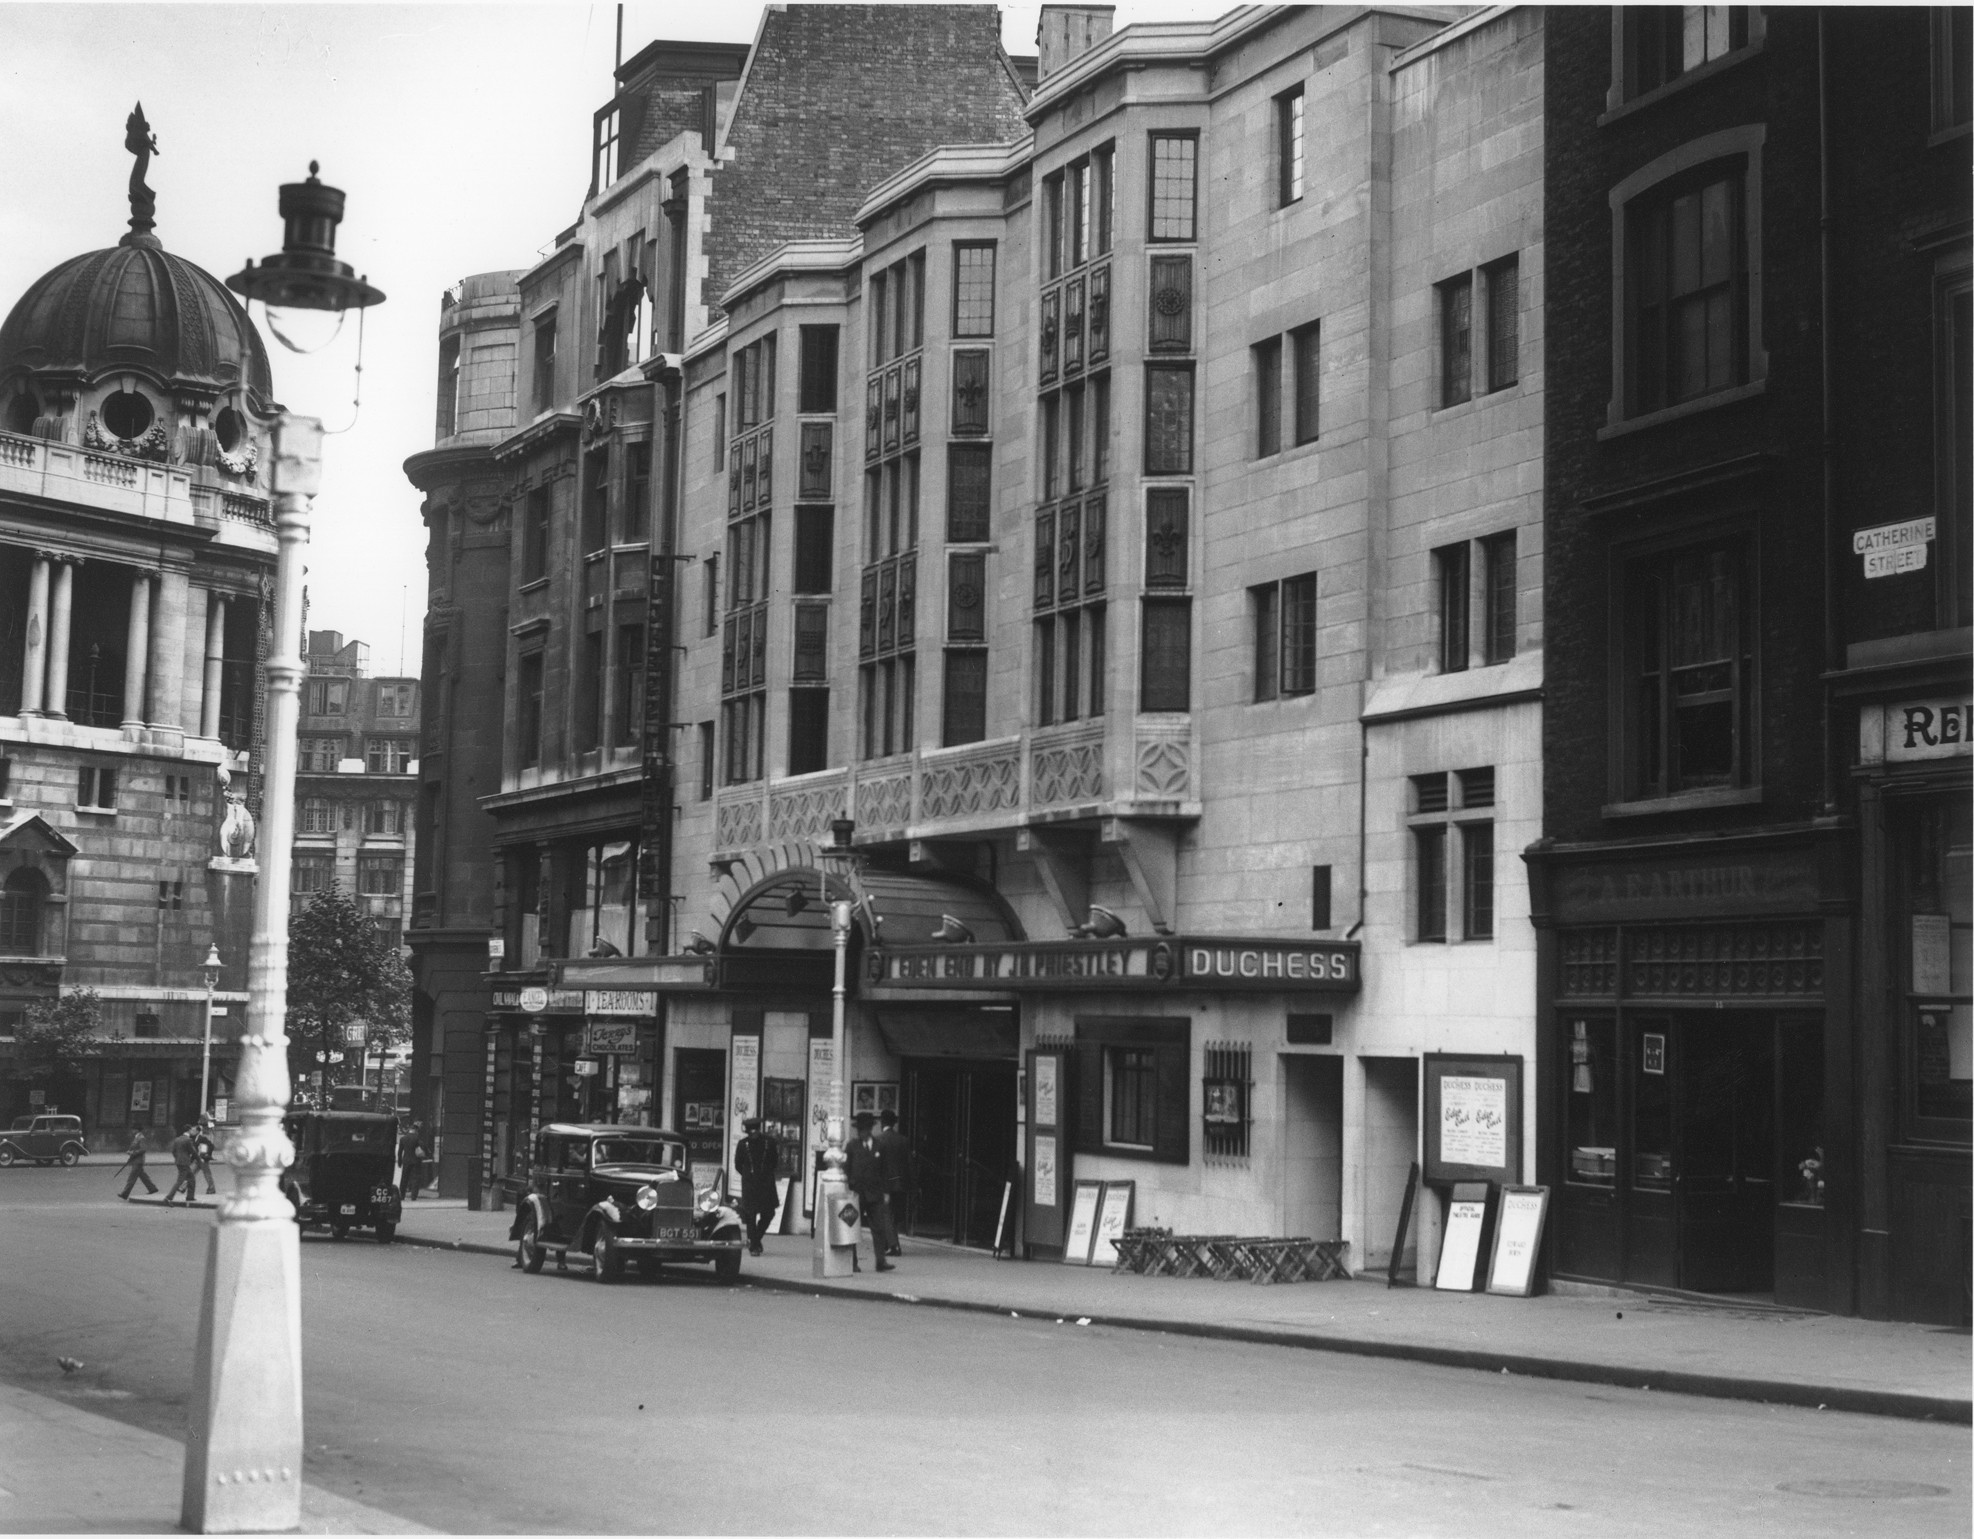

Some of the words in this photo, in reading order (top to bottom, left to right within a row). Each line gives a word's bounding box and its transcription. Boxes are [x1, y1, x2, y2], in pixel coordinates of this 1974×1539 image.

[1856, 522, 1934, 551] CATHERINE
[1868, 550, 1923, 573] STREET
[1191, 948, 1347, 980] DUCHESS
[592, 1044, 634, 1052] CHOCOLATES
[682, 1228, 699, 1239] 551
